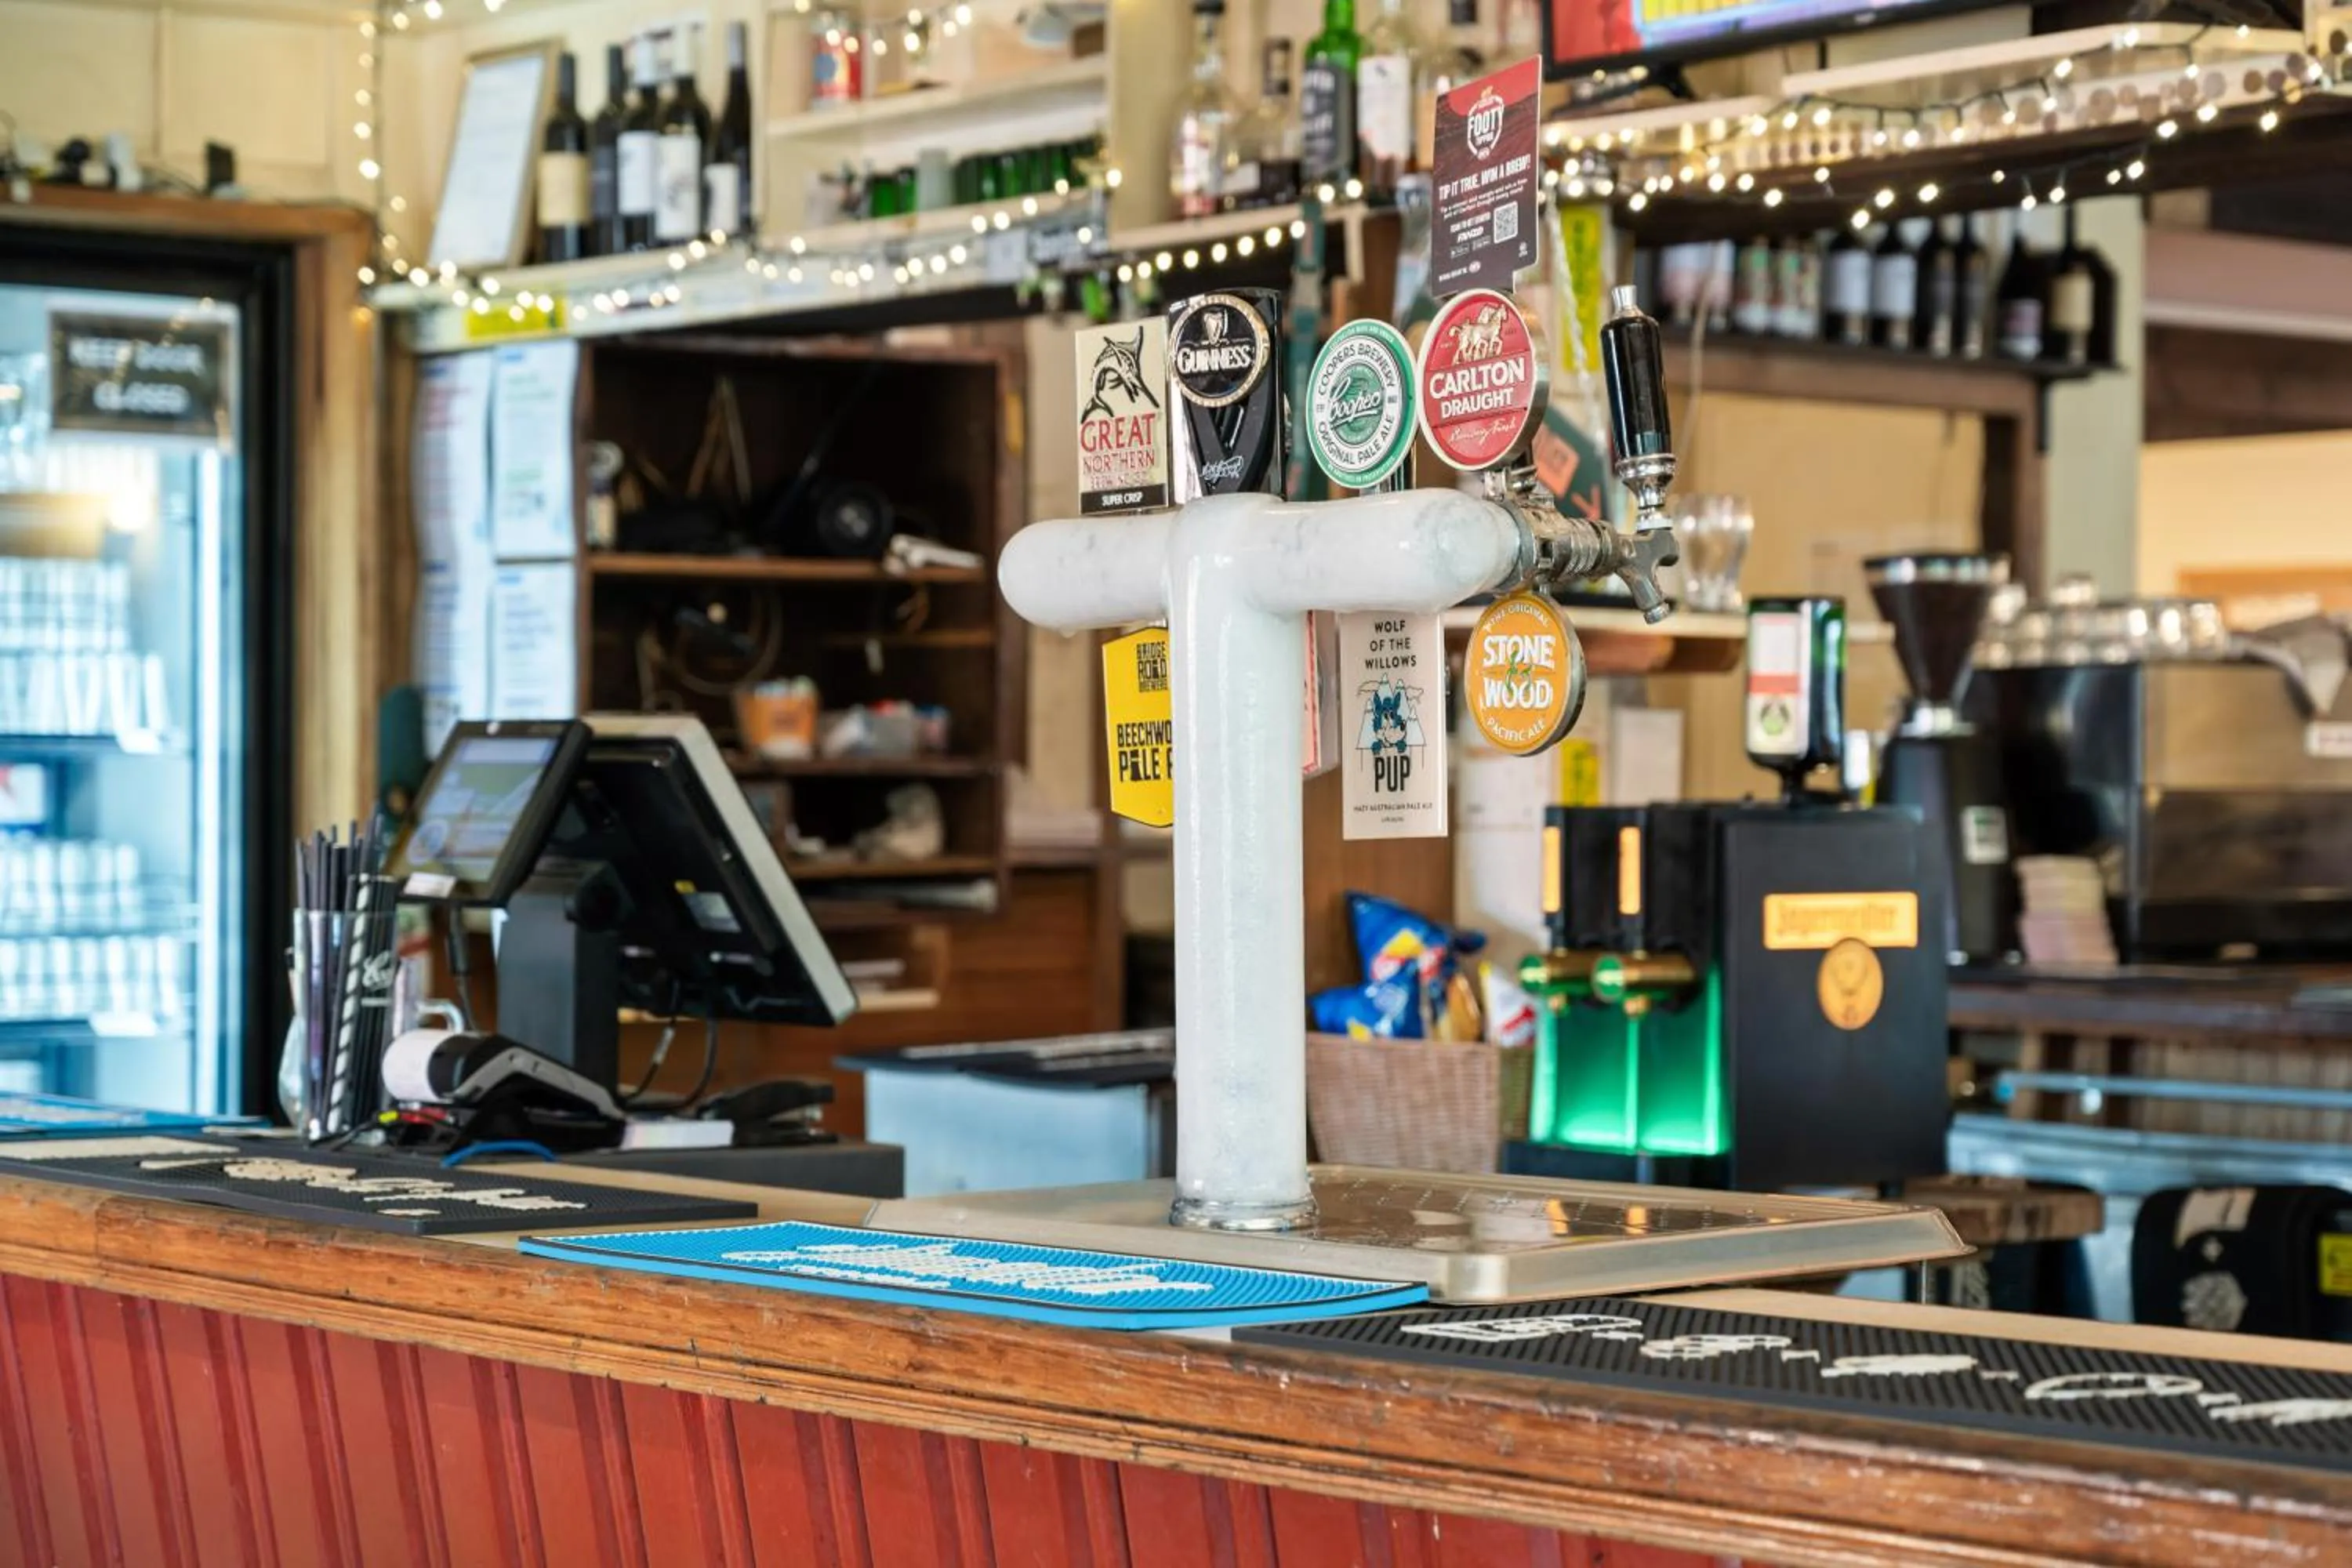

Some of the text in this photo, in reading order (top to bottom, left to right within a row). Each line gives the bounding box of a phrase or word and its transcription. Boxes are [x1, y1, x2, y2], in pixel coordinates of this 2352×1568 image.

[1468, 105, 1503, 138] FOOTY
[1439, 184, 1451, 201] TIP
[1451, 180, 1459, 197] IT
[1481, 166, 1498, 186] WIN
[1499, 164, 1504, 179] A
[1177, 345, 1251, 374] GUINNESS
[1318, 343, 1395, 396] COOPERS BREWERY
[1429, 358, 1526, 399] CARLTON
[1441, 387, 1514, 419] DRAUGHT
[1080, 413, 1156, 452] GREAT
[1318, 415, 1395, 465] ORIGINAL PALE ALE
[1083, 448, 1155, 474] NORTHERN
[1102, 492, 1143, 506] SUPER CRISP
[1374, 620, 1406, 633] WOLF
[1136, 641, 1167, 659] BRIDGE
[1370, 637, 1411, 652] OF THE
[1483, 634, 1556, 670] STONE
[1365, 655, 1417, 669] WILLOWS
[1483, 677, 1554, 709] WOOD
[1487, 717, 1545, 742] PACIFIC ALE
[1374, 755, 1410, 793] PUP
